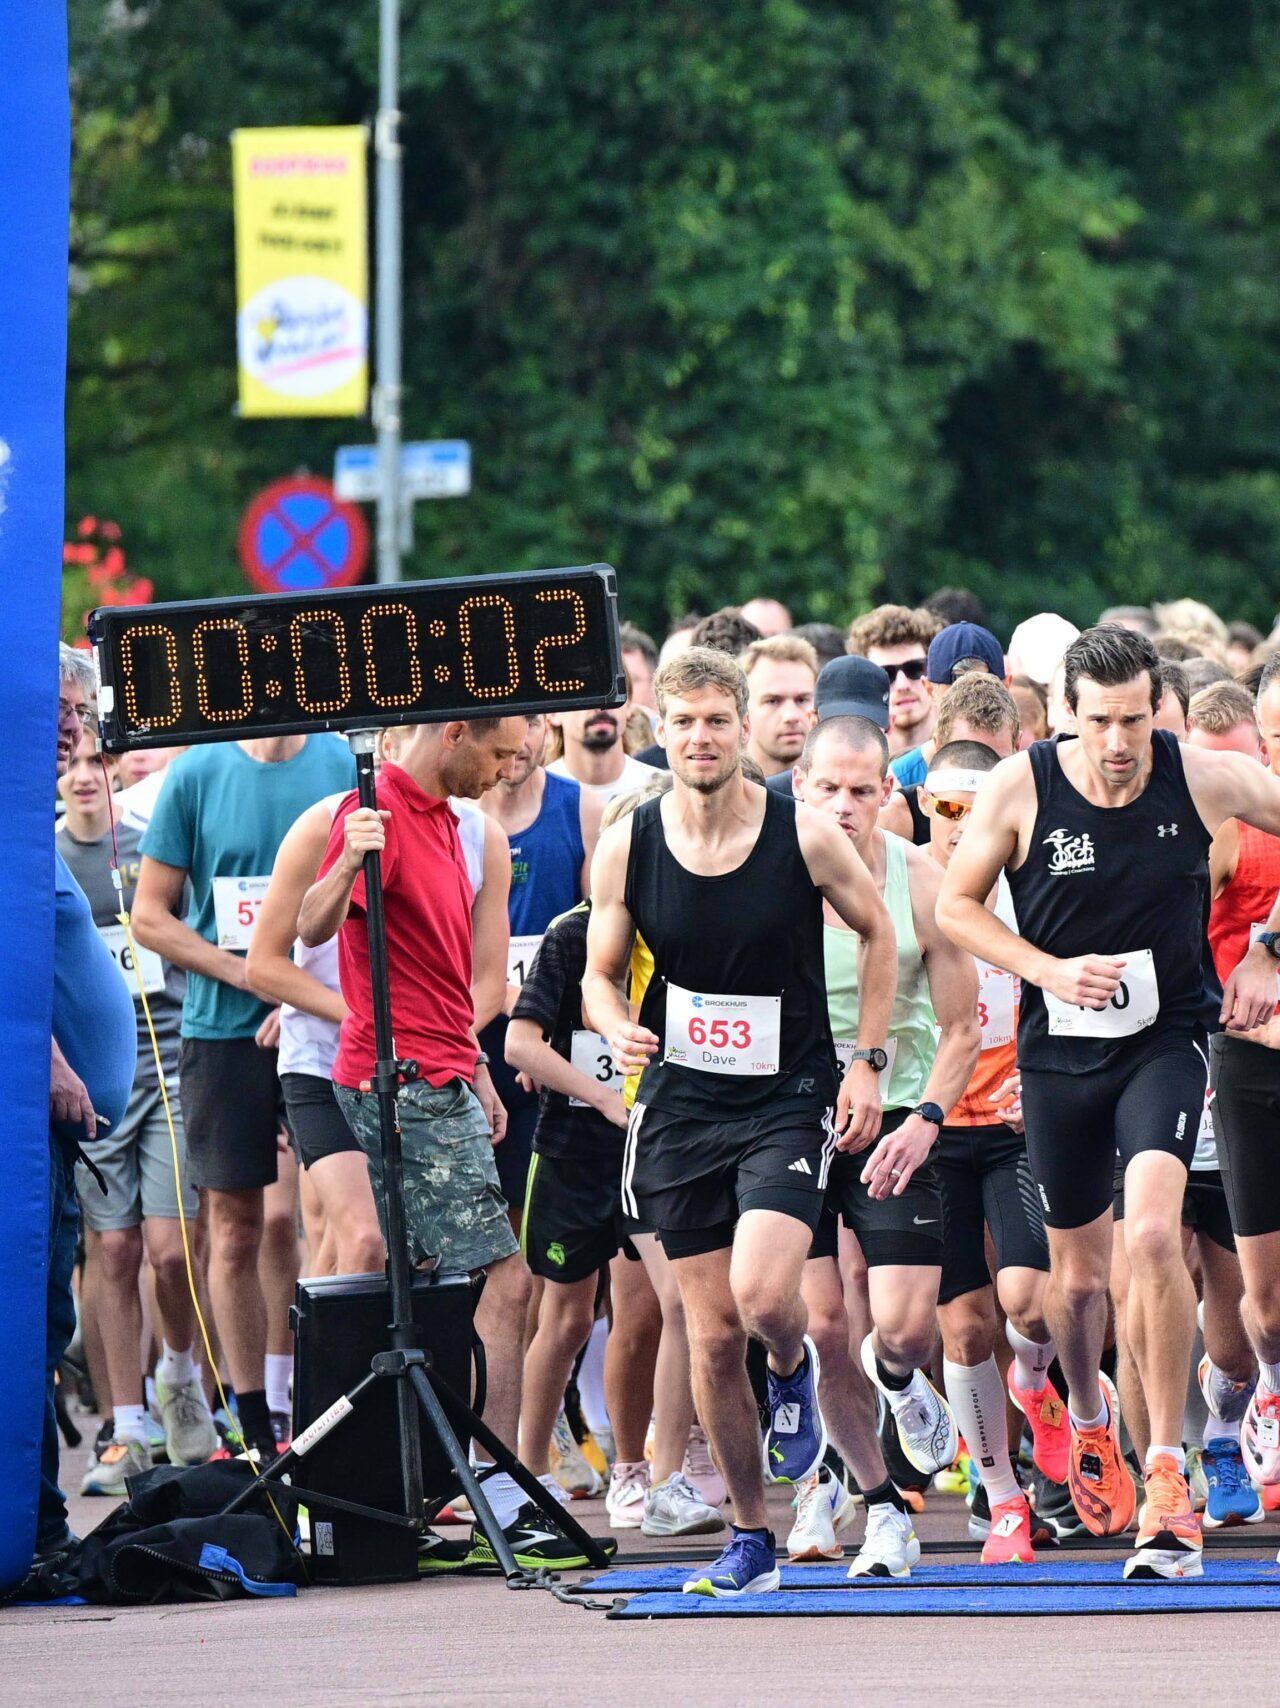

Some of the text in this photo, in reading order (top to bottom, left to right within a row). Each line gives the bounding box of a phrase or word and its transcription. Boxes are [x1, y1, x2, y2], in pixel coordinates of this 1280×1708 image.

[121, 589, 586, 727] 00:00:02
[704, 999, 748, 1008] BROEKHUIS
[688, 1017, 752, 1049] 653
[702, 1051, 737, 1066] Dave
[751, 1062, 776, 1072] 10km
[1174, 1111, 1188, 1141] FUSION
[1037, 1183, 1051, 1213] FUSION
[971, 1388, 989, 1454] COMPRESSPORT
